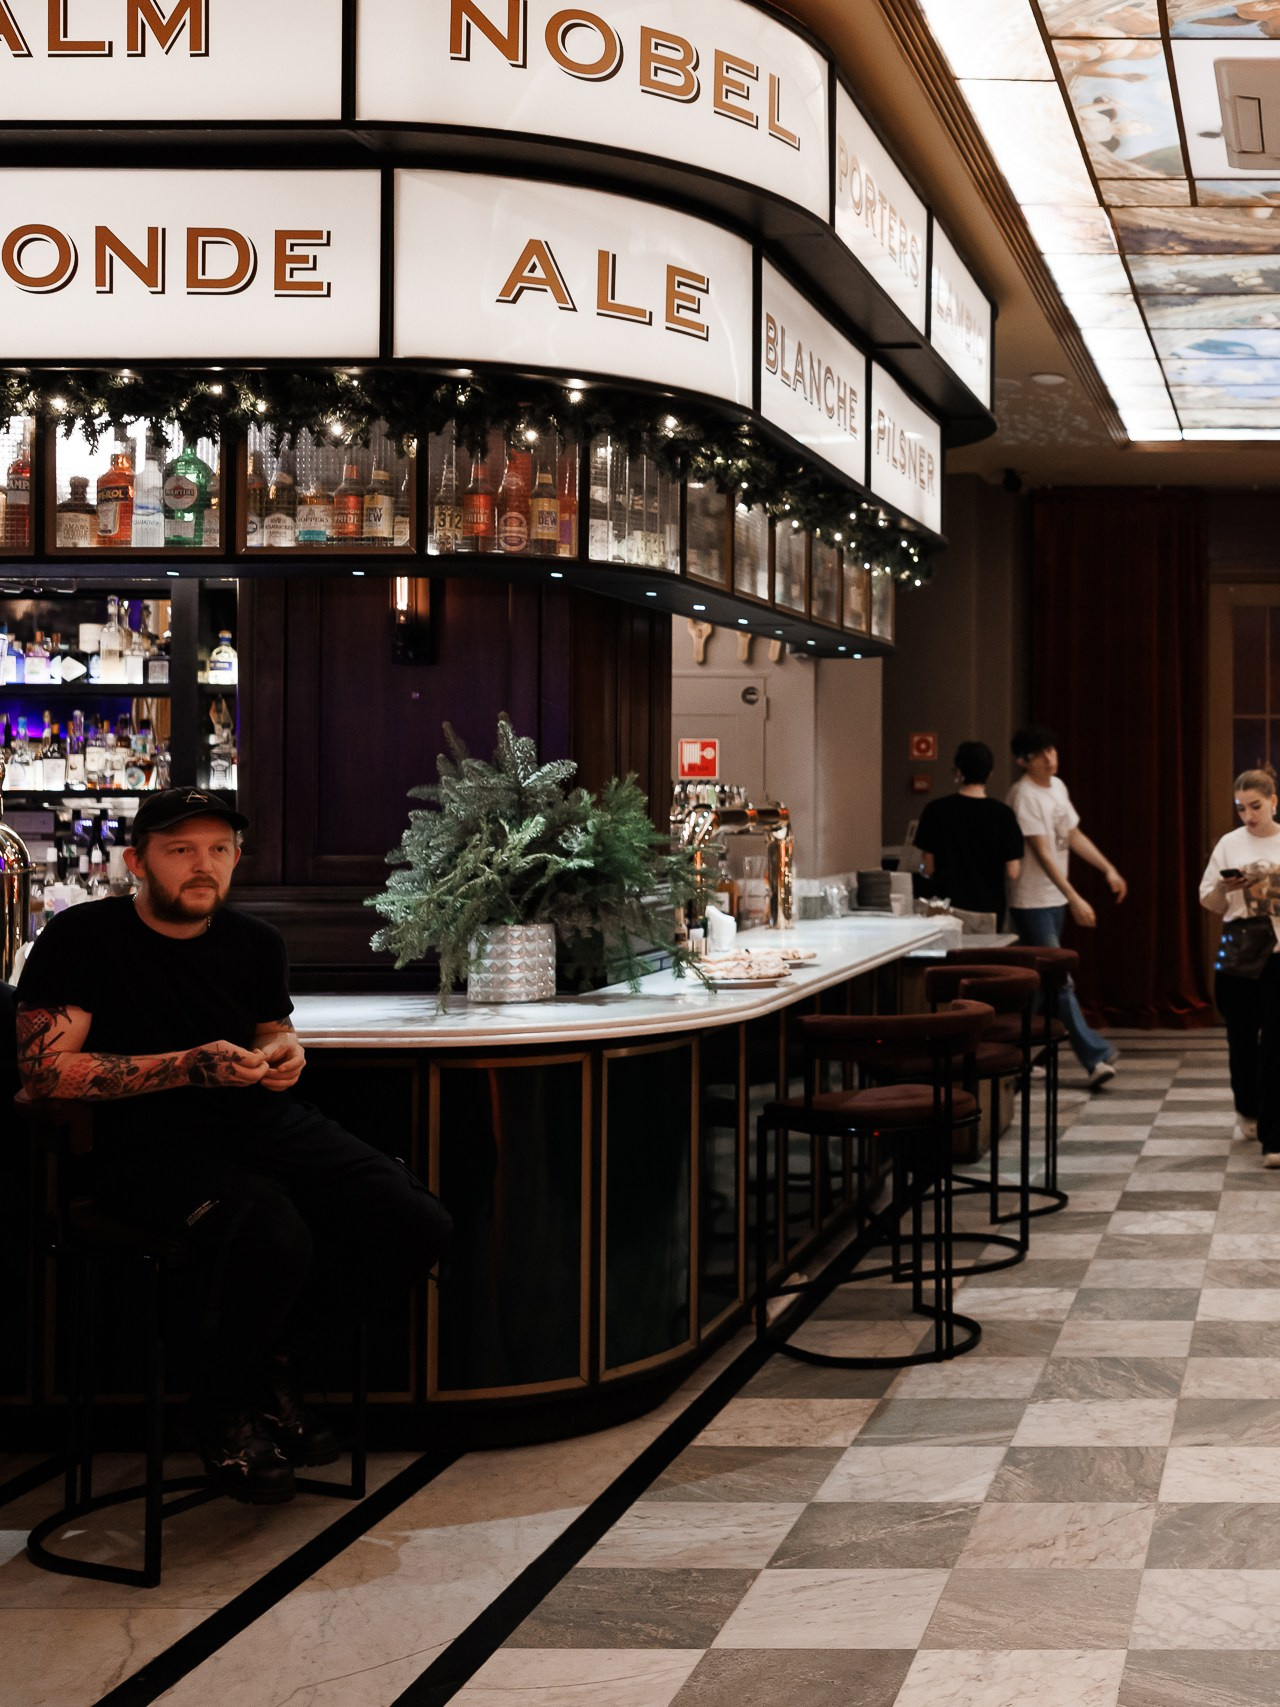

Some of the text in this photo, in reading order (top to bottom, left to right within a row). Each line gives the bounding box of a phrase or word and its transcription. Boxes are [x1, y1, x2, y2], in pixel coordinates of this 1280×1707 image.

[449, 0, 800, 152] NOBEL
[838, 133, 919, 287] PORTERS
[1, 223, 332, 298] ONDE
[495, 238, 709, 341] ALE
[936, 265, 984, 365] LAMBIC
[765, 312, 858, 440] BLANCHE
[7, 479, 30, 489] AMP
[877, 408, 935, 497] PILSNER
[438, 511, 462, 529] 312
